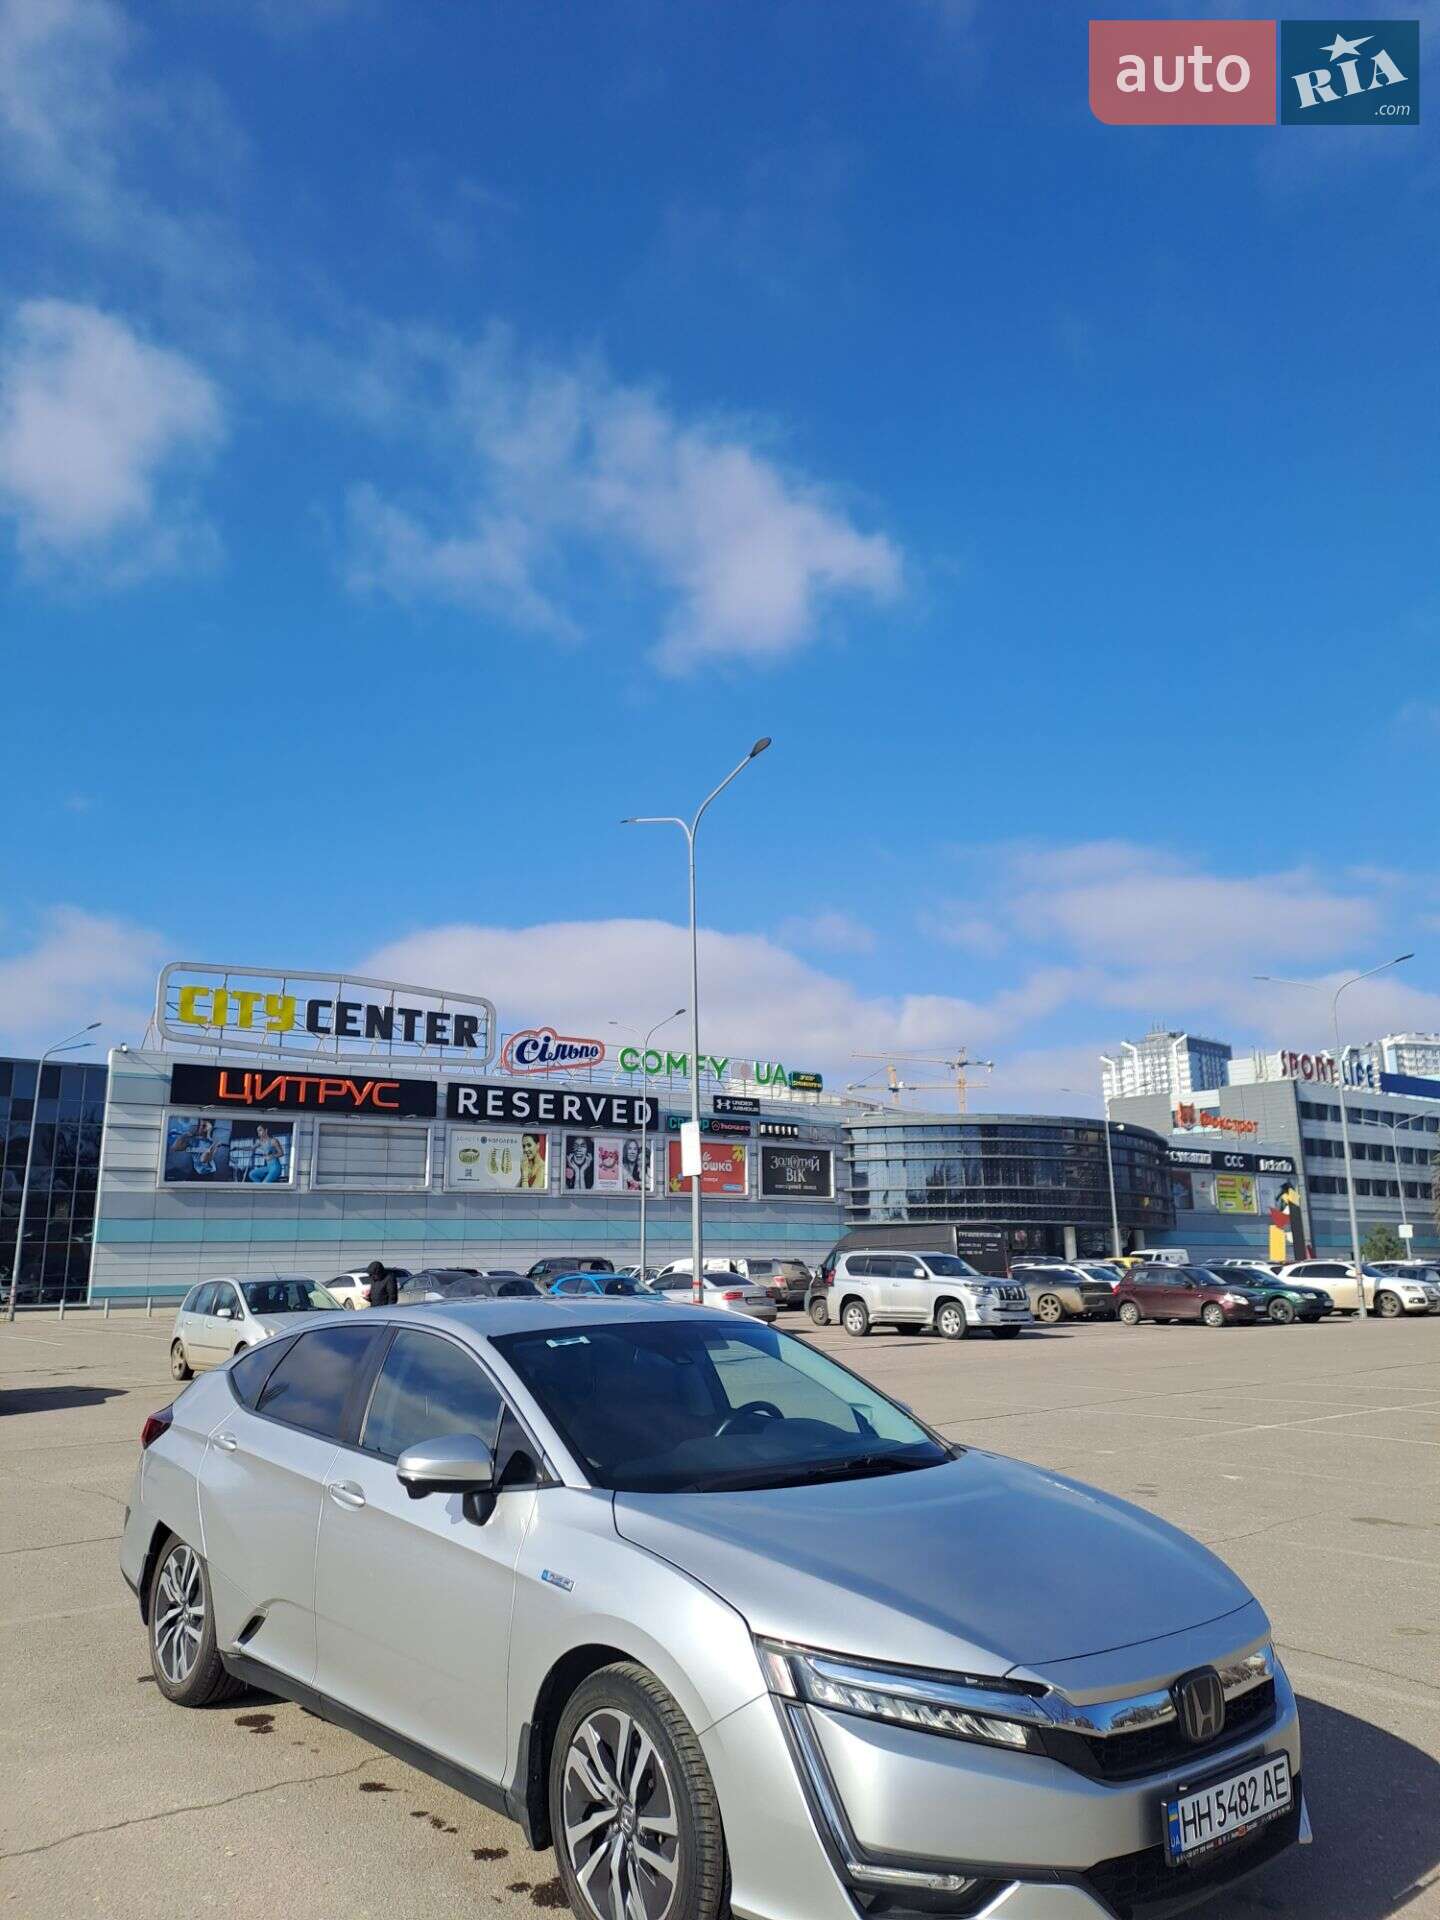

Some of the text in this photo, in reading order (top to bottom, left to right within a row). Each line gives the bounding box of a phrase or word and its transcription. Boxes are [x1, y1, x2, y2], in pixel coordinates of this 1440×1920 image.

[178, 986, 479, 1048] CITY CENTER
[515, 1035, 599, 1065] Сільпо
[618, 1047, 729, 1081] COMFY
[218, 1071, 400, 1108] ЦИТРУС
[457, 1087, 652, 1125] RESERVED
